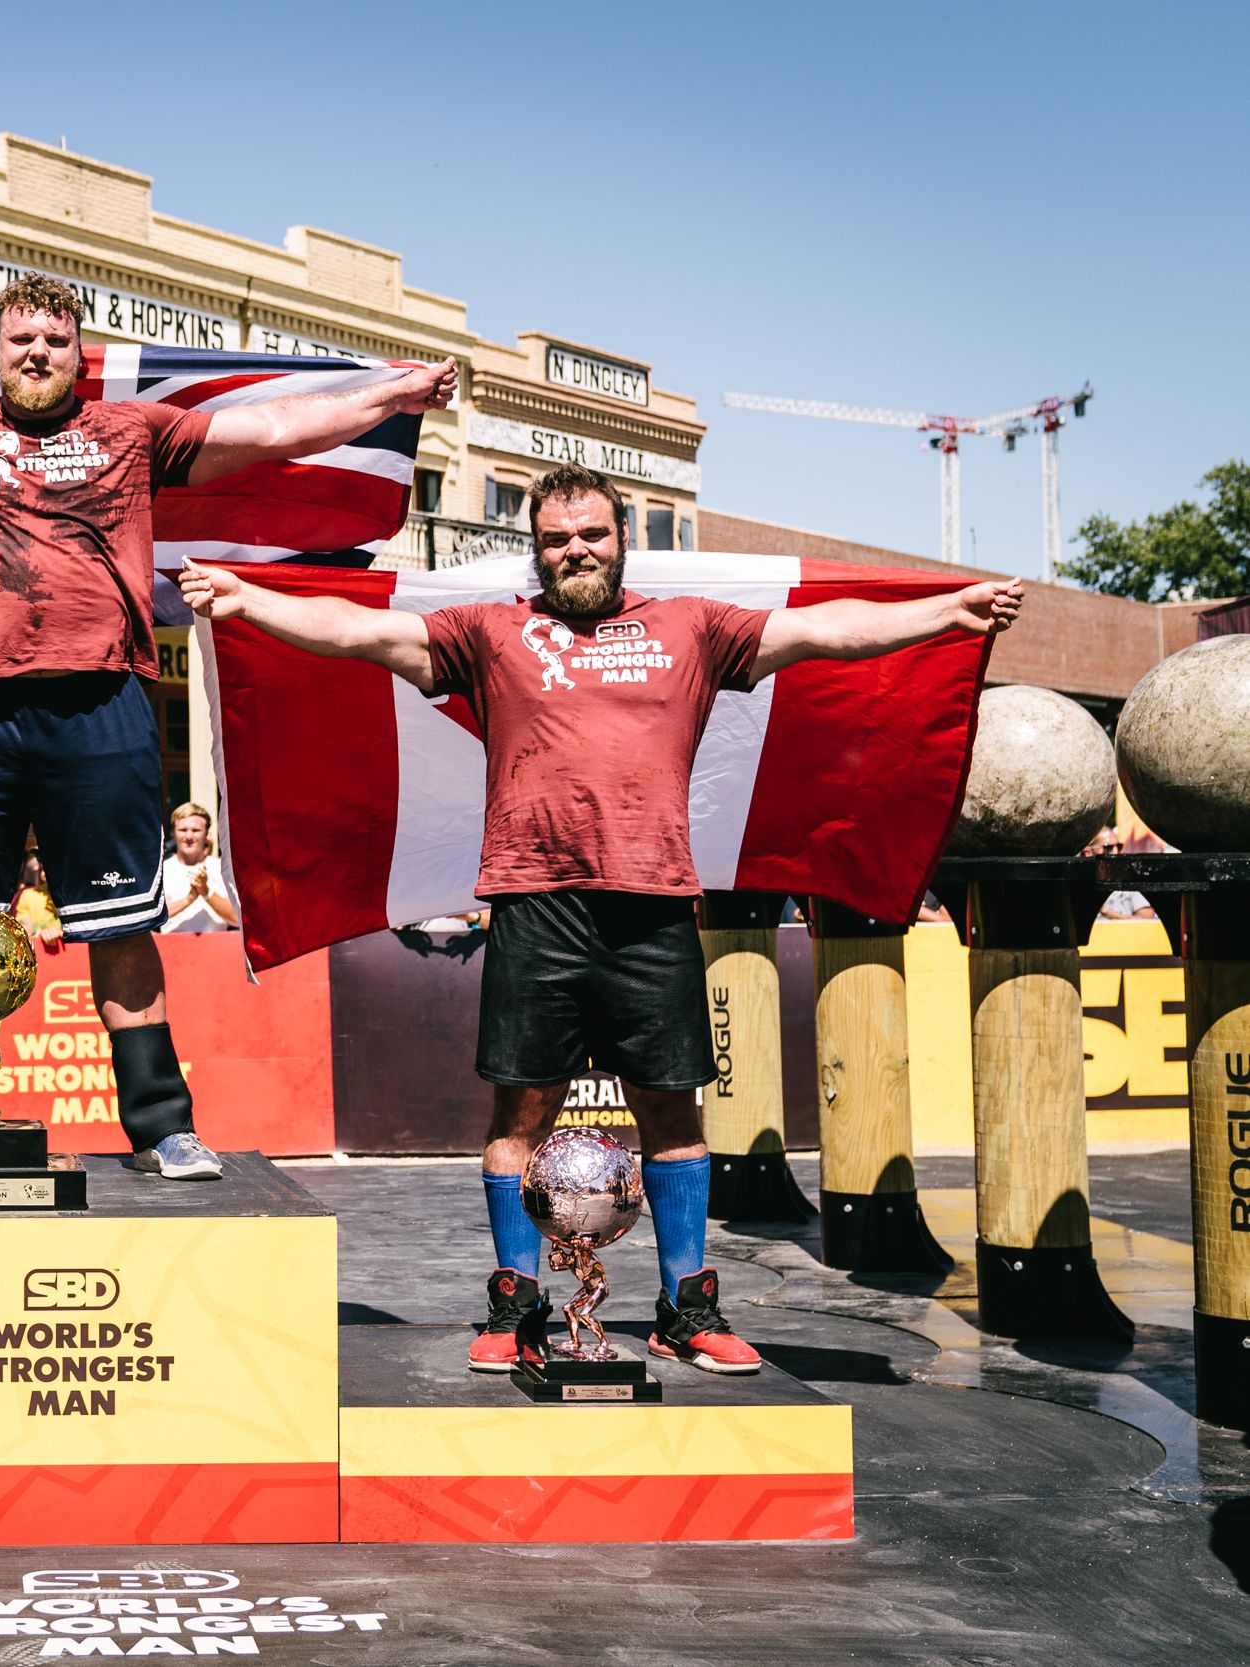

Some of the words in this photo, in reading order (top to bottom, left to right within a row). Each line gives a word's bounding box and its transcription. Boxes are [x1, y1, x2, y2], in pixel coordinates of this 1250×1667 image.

[108, 294, 123, 330] &
[131, 298, 224, 350] HOPKINS
[554, 354, 568, 381] N.
[573, 358, 642, 401] DINGLEY.
[15, 453, 110, 472] STRONGEST
[531, 430, 587, 464] STAR
[601, 446, 652, 478] MILL.
[45, 468, 87, 483] MAN
[464, 533, 524, 564] FRANCISCO
[596, 620, 645, 643] SBD
[571, 653, 673, 669] STRONGEST
[580, 640, 663, 656] WORLD'S
[602, 668, 647, 684] MAN
[13, 1033, 112, 1060] WORL
[712, 987, 734, 1098] ROGUE
[1225, 1052, 1250, 1232] ROGUE
[24, 1269, 120, 1311] SBD
[27, 1389, 116, 1417] MAN
[23, 1569, 241, 1594] SBD
[38, 1635, 261, 1657] MAN
